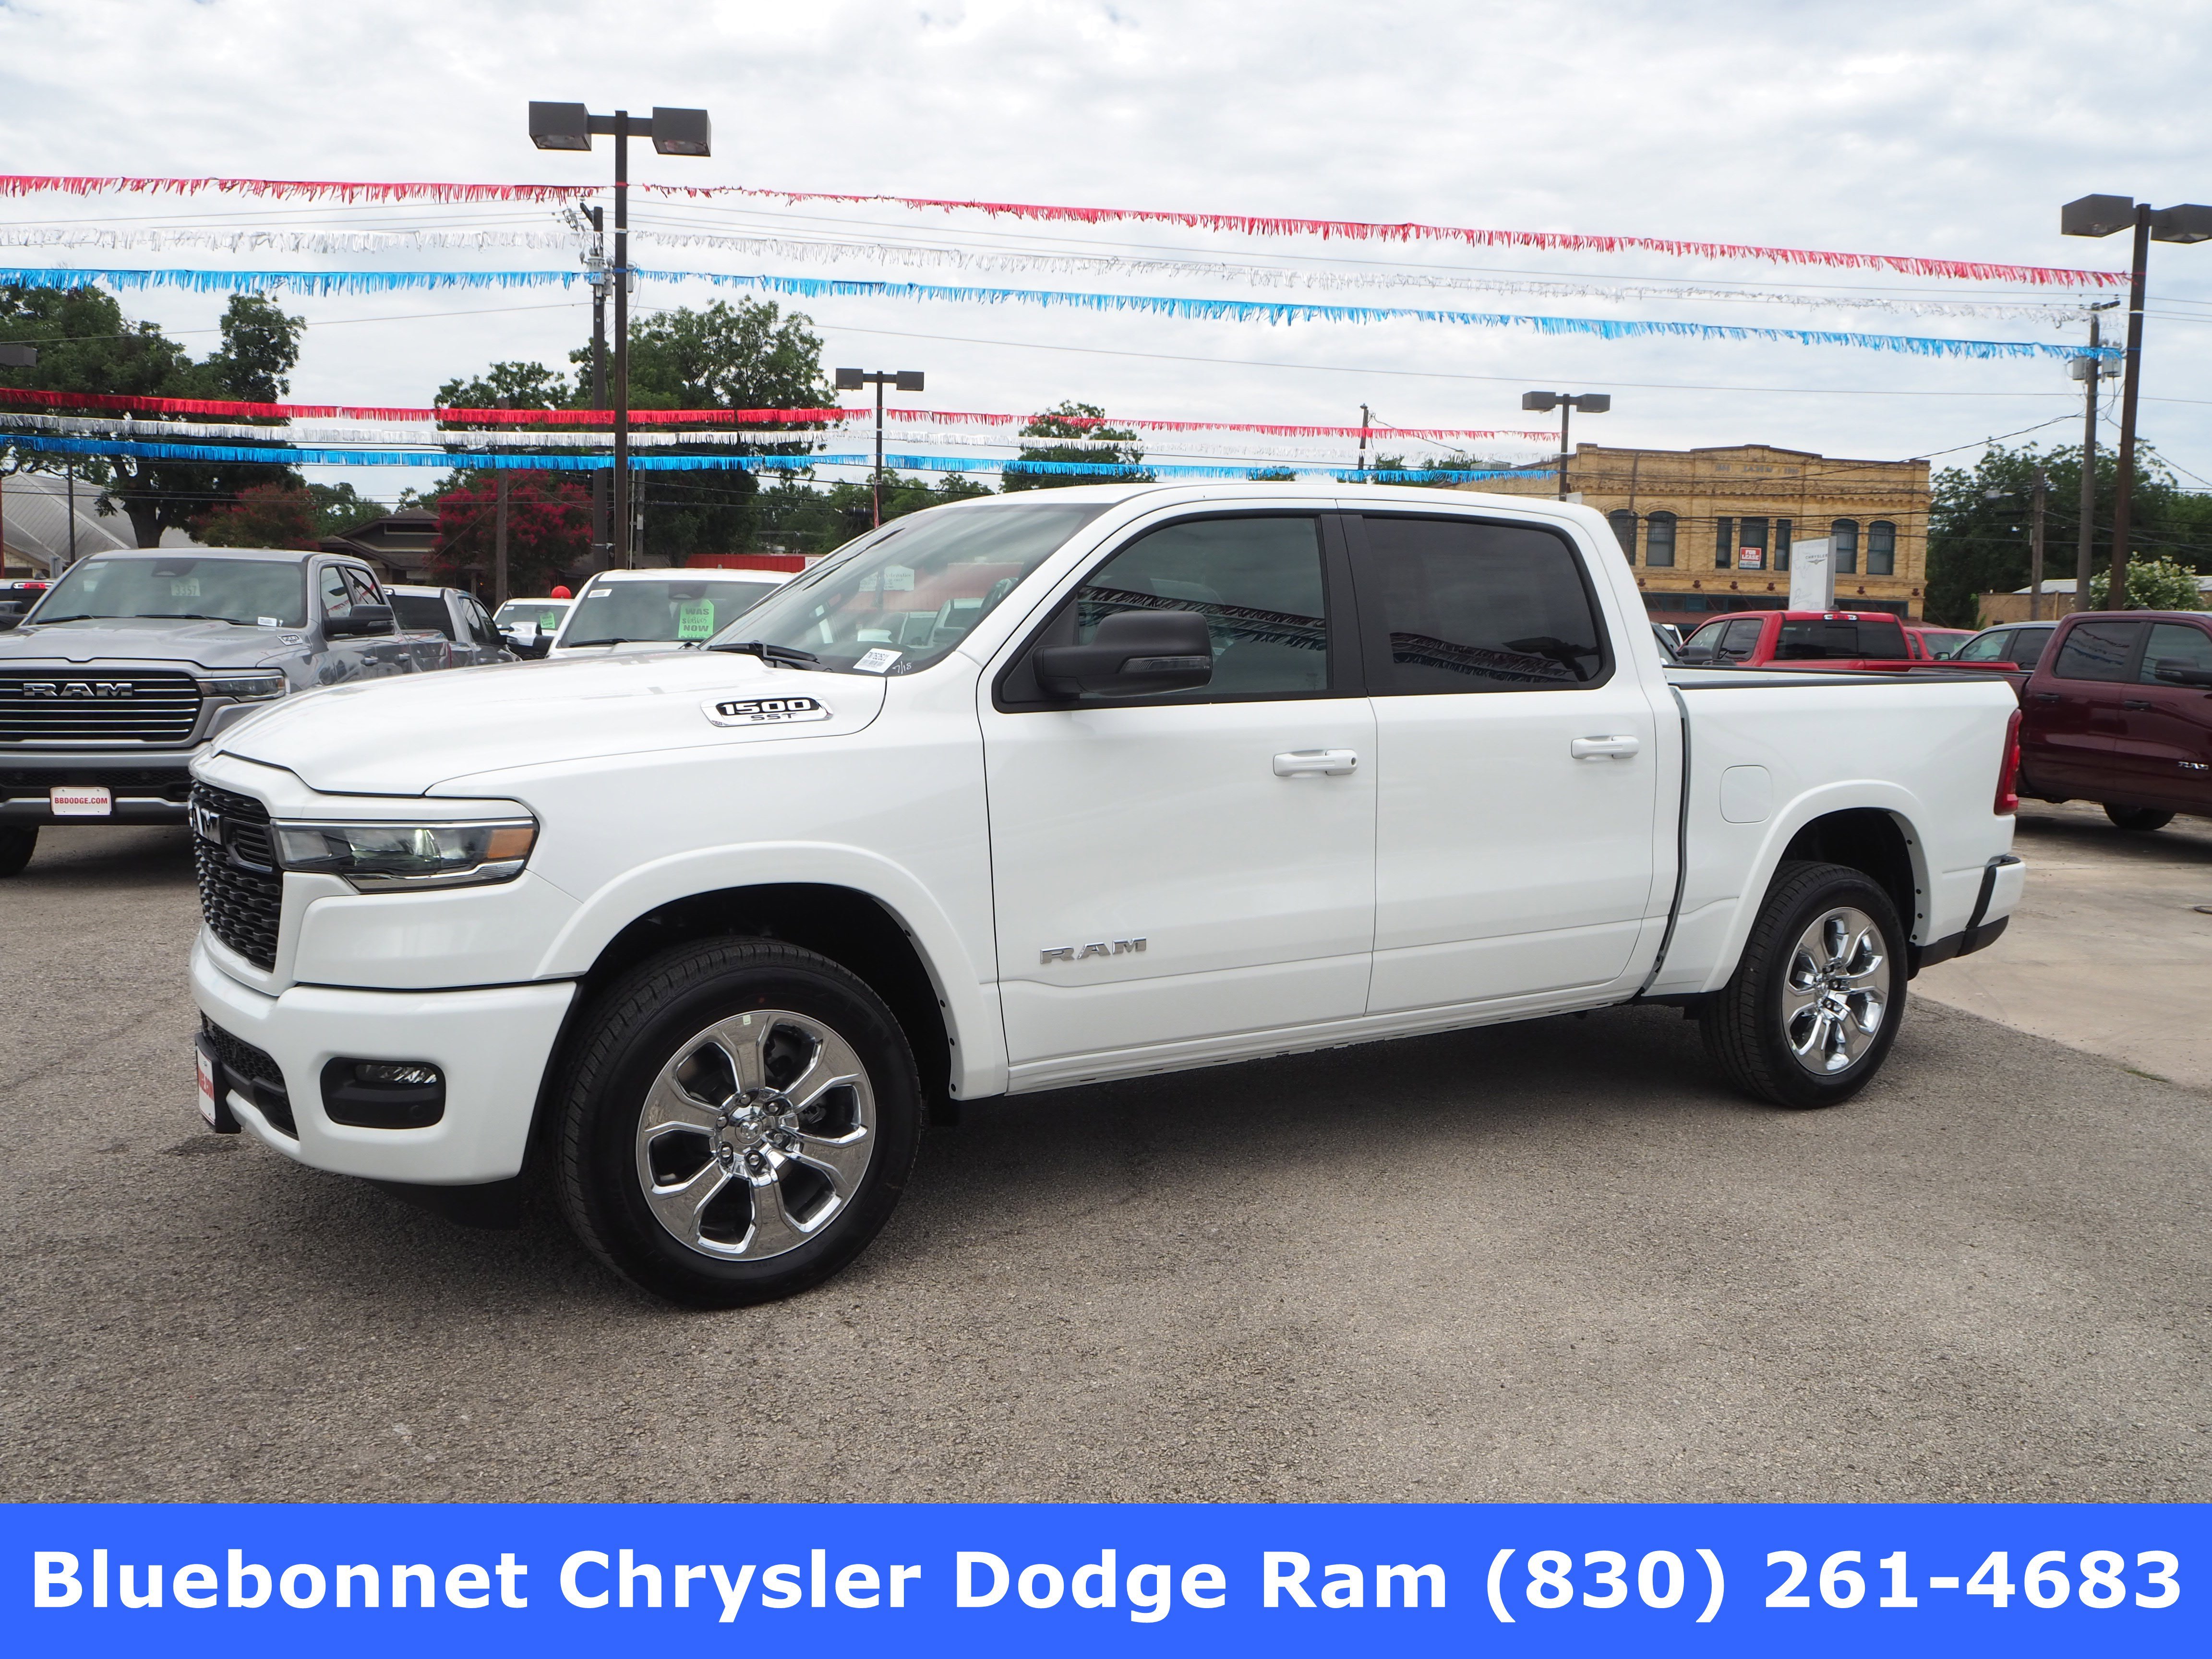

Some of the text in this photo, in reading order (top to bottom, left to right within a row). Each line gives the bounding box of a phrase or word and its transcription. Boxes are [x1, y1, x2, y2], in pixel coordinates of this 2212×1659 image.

[23, 683, 132, 697] RAM
[720, 699, 811, 716] 1500
[750, 712, 797, 721] SST
[1040, 937, 1147, 964] RAM
